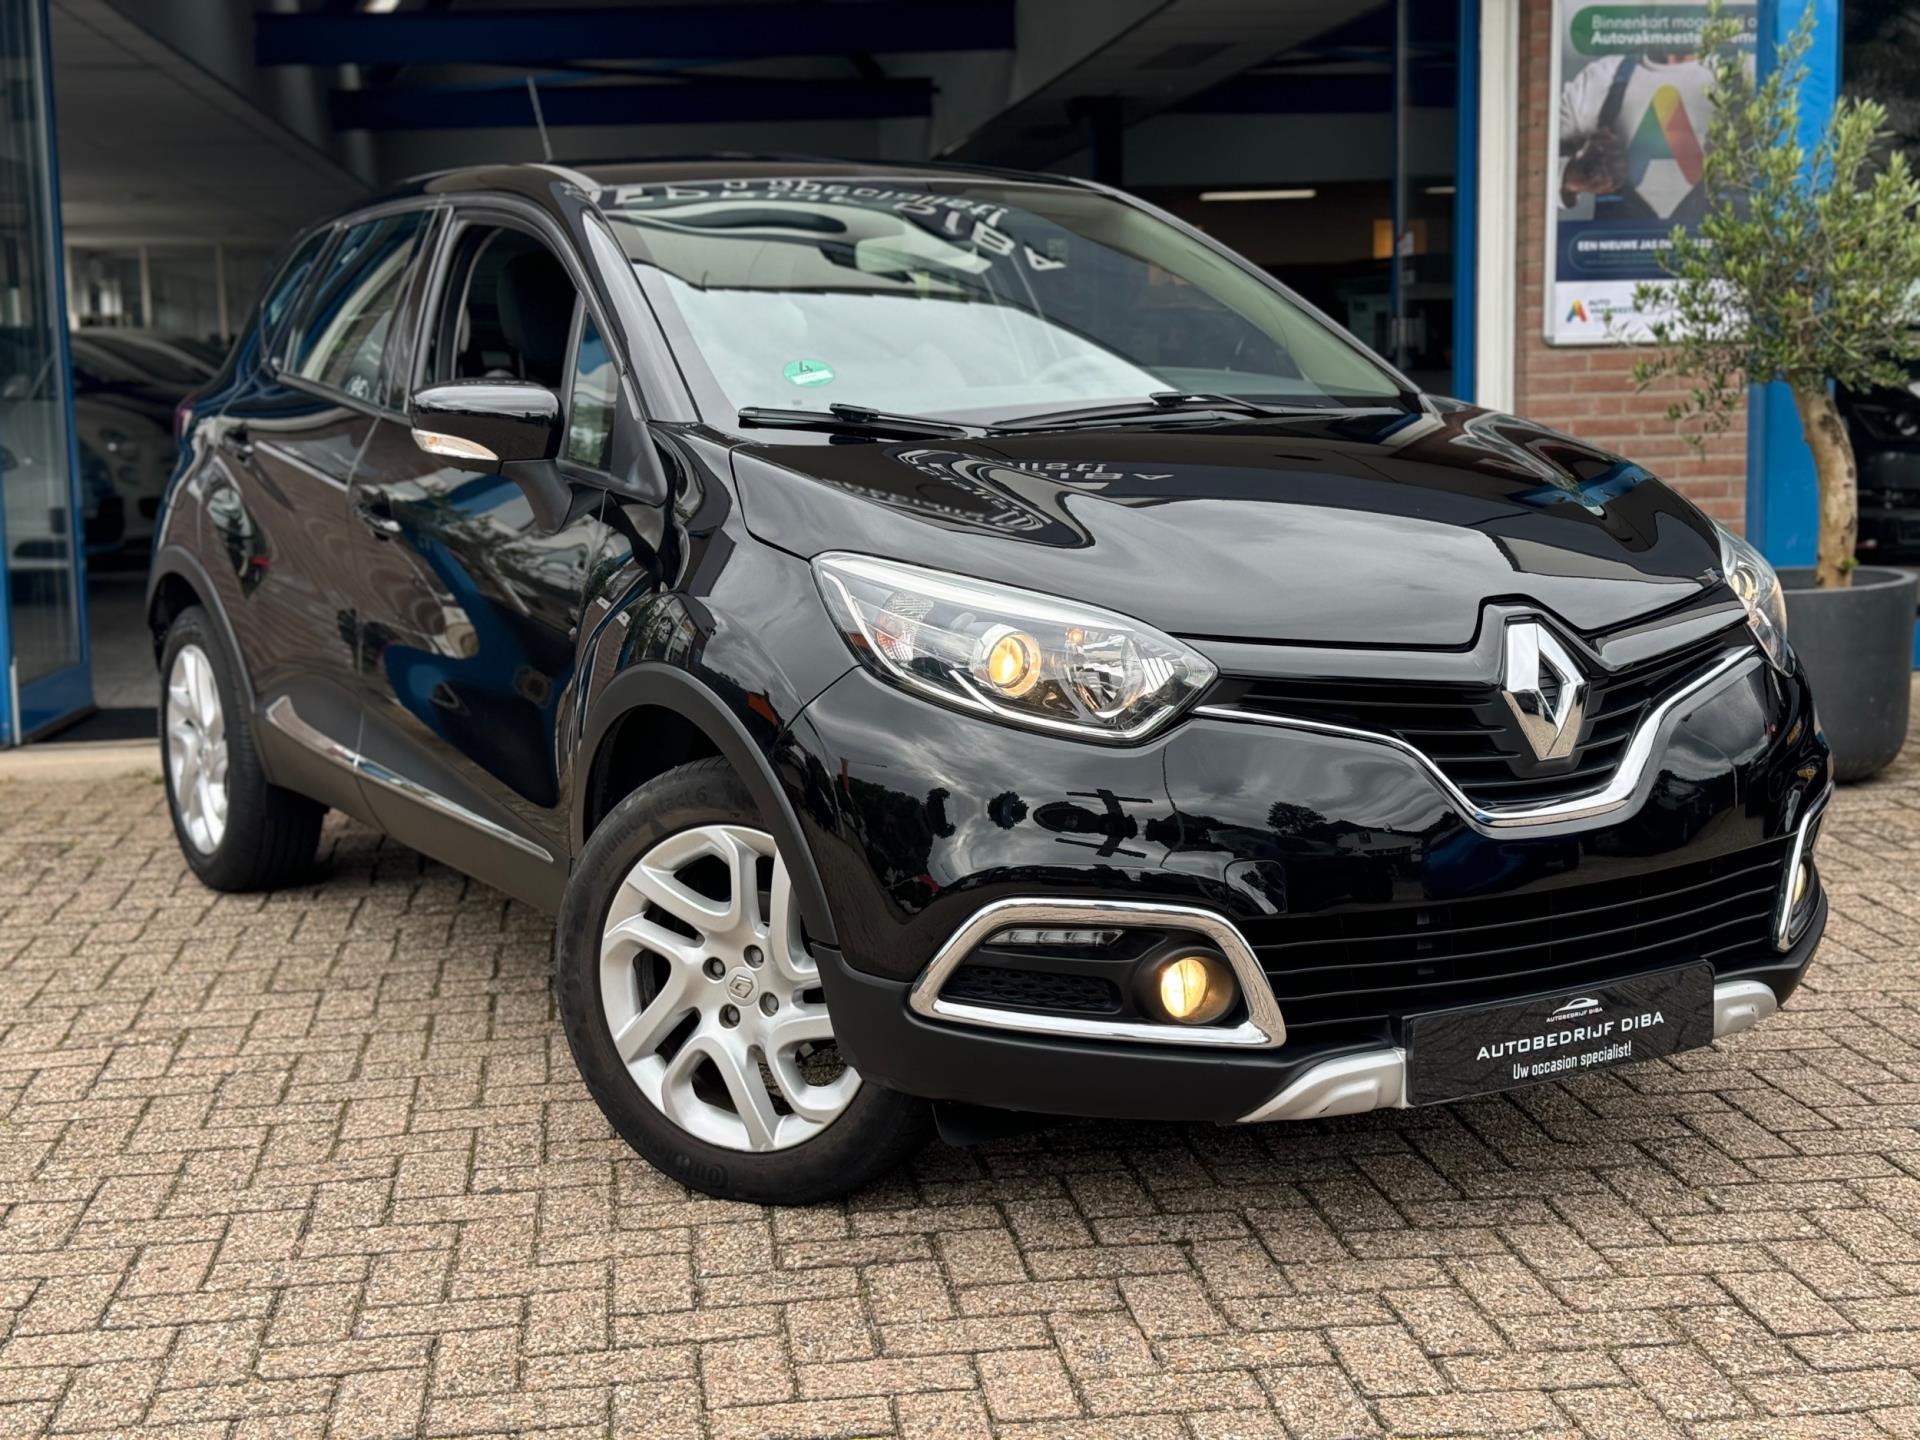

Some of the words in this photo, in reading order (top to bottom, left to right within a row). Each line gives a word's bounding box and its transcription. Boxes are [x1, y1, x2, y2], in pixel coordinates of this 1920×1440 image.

[1592, 14, 1669, 30] Binnenkort
[1591, 30, 1704, 46] Autovakmeeste
[1546, 1010, 1588, 1023] AUTOBEDRIJF
[1476, 1021, 1615, 1061] AUTOBEDRIJF
[1621, 1011, 1665, 1032] DIBA
[1513, 1063, 1529, 1080] Uw
[1531, 1055, 1577, 1076] occasion
[1580, 1040, 1632, 1066] specialist!
